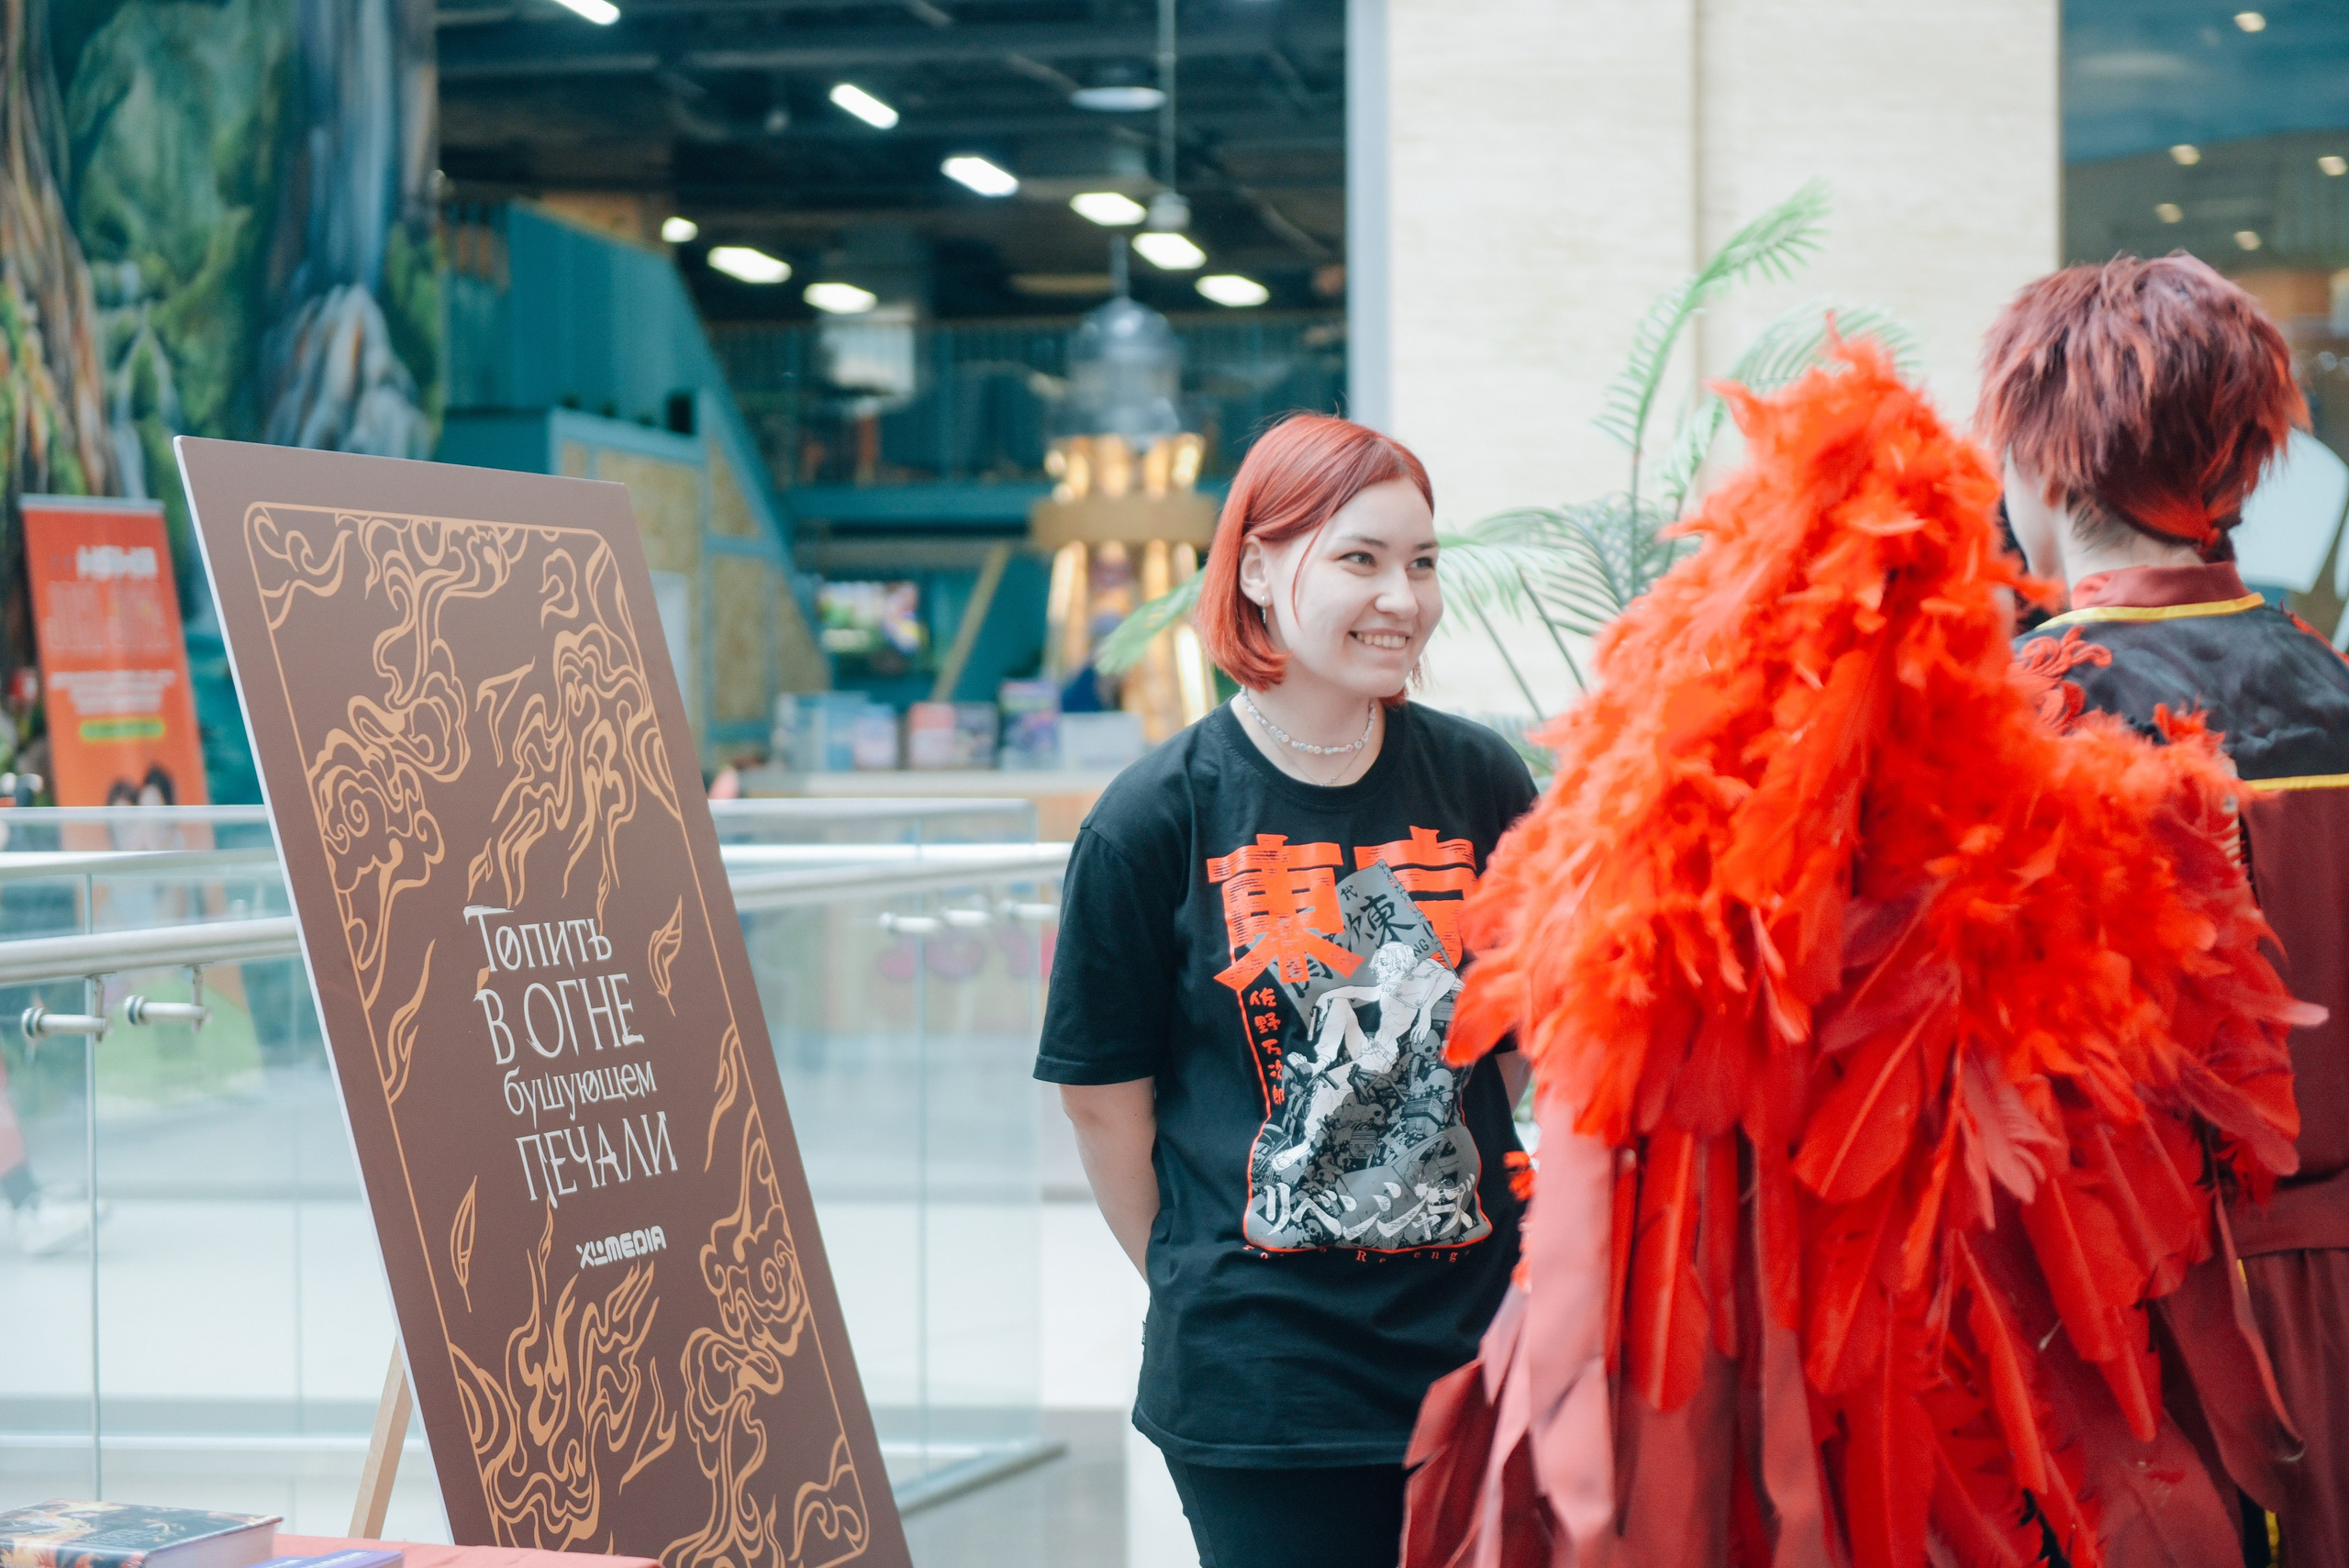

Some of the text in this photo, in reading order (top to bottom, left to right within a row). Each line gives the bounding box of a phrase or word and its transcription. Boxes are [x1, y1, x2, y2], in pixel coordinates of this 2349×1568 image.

[473, 973, 645, 1064] В ОГНЕ
[504, 1061, 658, 1129] бушующем
[515, 1110, 678, 1209] ПЕЧАЛИ
